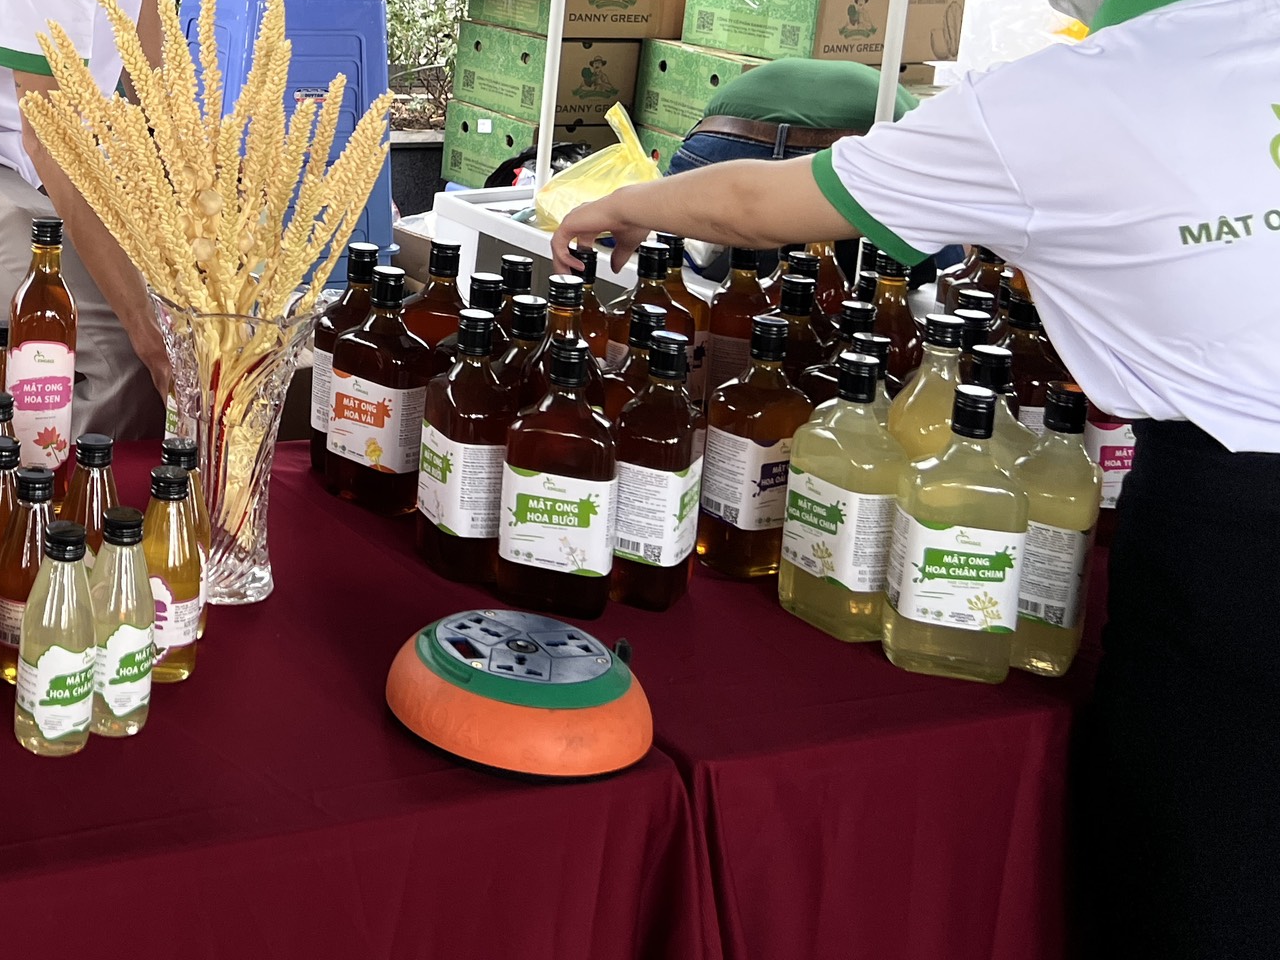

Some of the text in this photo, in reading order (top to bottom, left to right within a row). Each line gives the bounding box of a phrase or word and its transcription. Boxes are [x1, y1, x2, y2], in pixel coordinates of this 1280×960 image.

[569, 12, 649, 23] DANNY GREEN
[823, 43, 855, 54] DANNY
[556, 104, 631, 113] DANNY GRN
[1178, 214, 1253, 244] MẬT
[23, 382, 63, 394] MẬT ONG
[24, 395, 61, 404] HOA SEN
[343, 397, 377, 413] MẬT ONG
[344, 409, 360, 419] HOA
[1104, 459, 1121, 467] HOA
[528, 497, 578, 513] MẬT ONG
[798, 499, 827, 516] MẬT ONG
[527, 511, 578, 526] HOA BƯỞI
[788, 506, 836, 531] HOA CHÂN CHIM
[943, 554, 990, 566] MẬT ONG
[925, 565, 1004, 578] HOA CHÂN CHIM
[120, 666, 139, 677] HOA
[66, 673, 85, 688] MẬT
[49, 689, 70, 699] HOA
